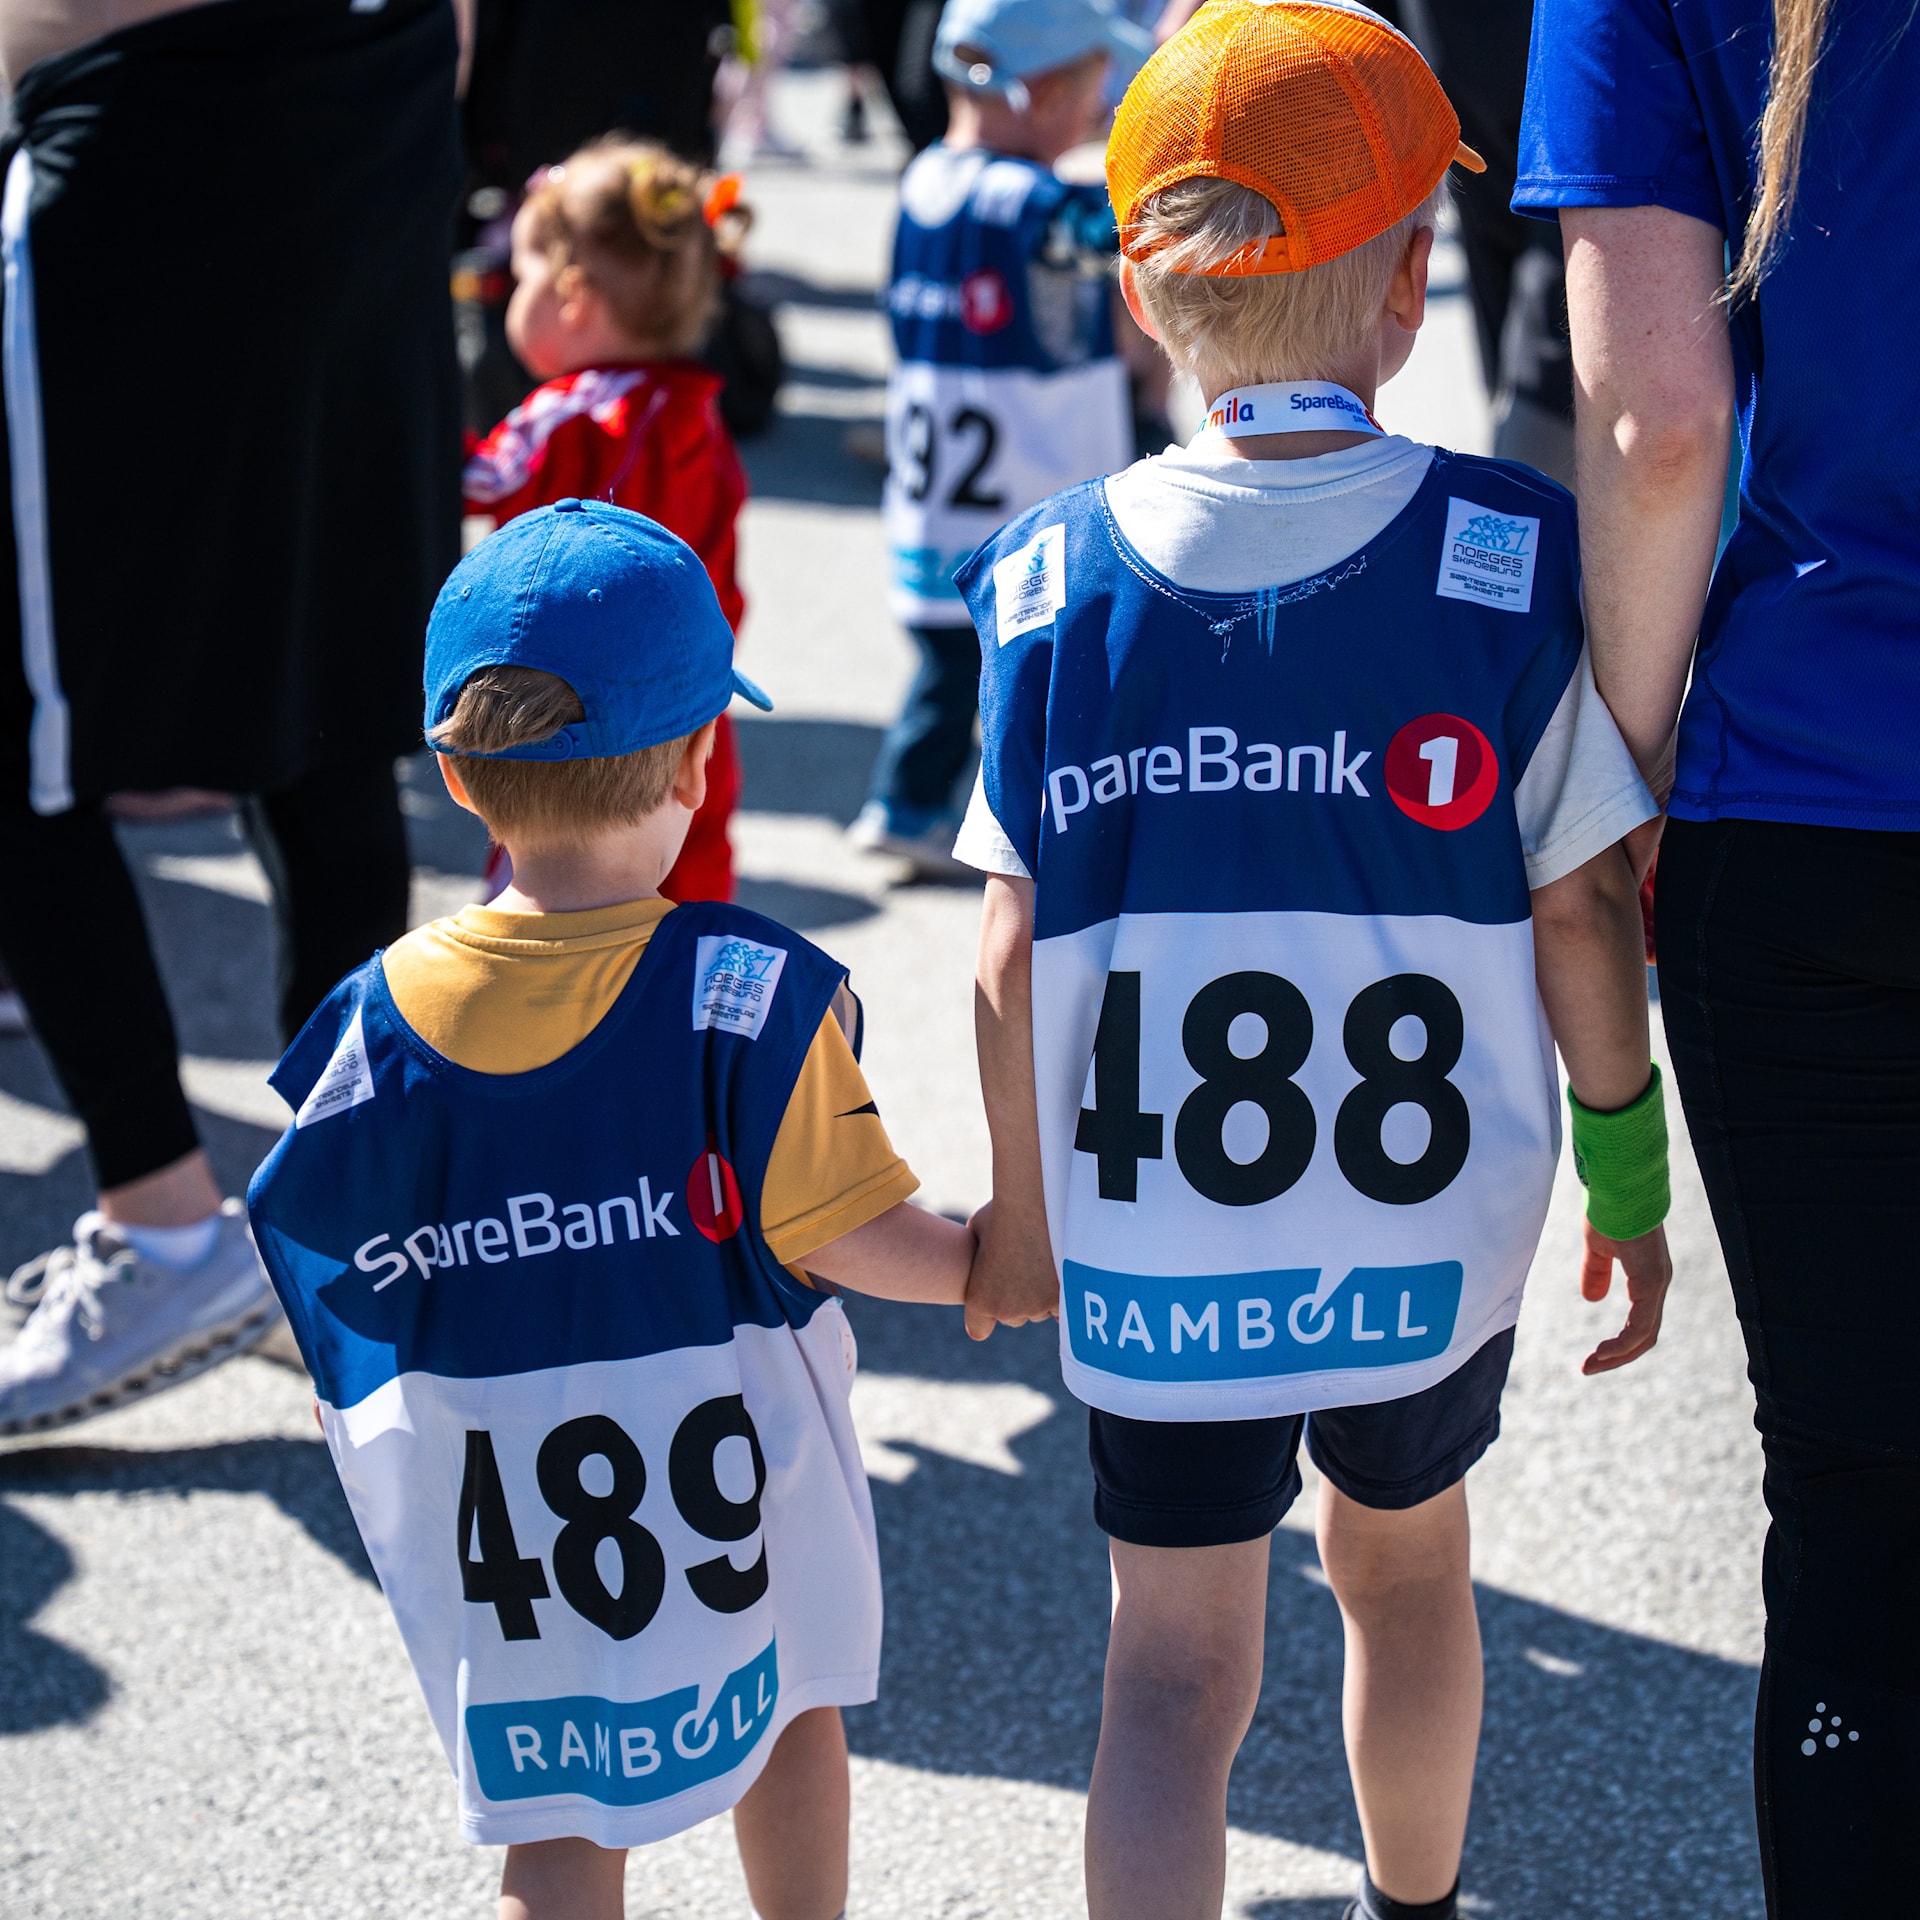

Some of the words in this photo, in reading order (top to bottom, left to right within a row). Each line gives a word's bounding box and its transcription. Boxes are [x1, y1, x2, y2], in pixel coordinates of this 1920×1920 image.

[1209, 397, 1255, 427] mila
[1290, 393, 1366, 417] SpareBank
[1452, 555, 1522, 578] SKIFORBUND
[1453, 543, 1523, 569] NORGES
[1041, 726, 1373, 835] pareBank
[1418, 735, 1459, 807] 1
[704, 972, 765, 994] NORGES
[1074, 970, 1471, 1207] 488
[353, 1175, 681, 1293] SpareBank
[457, 1393, 769, 1642] 489
